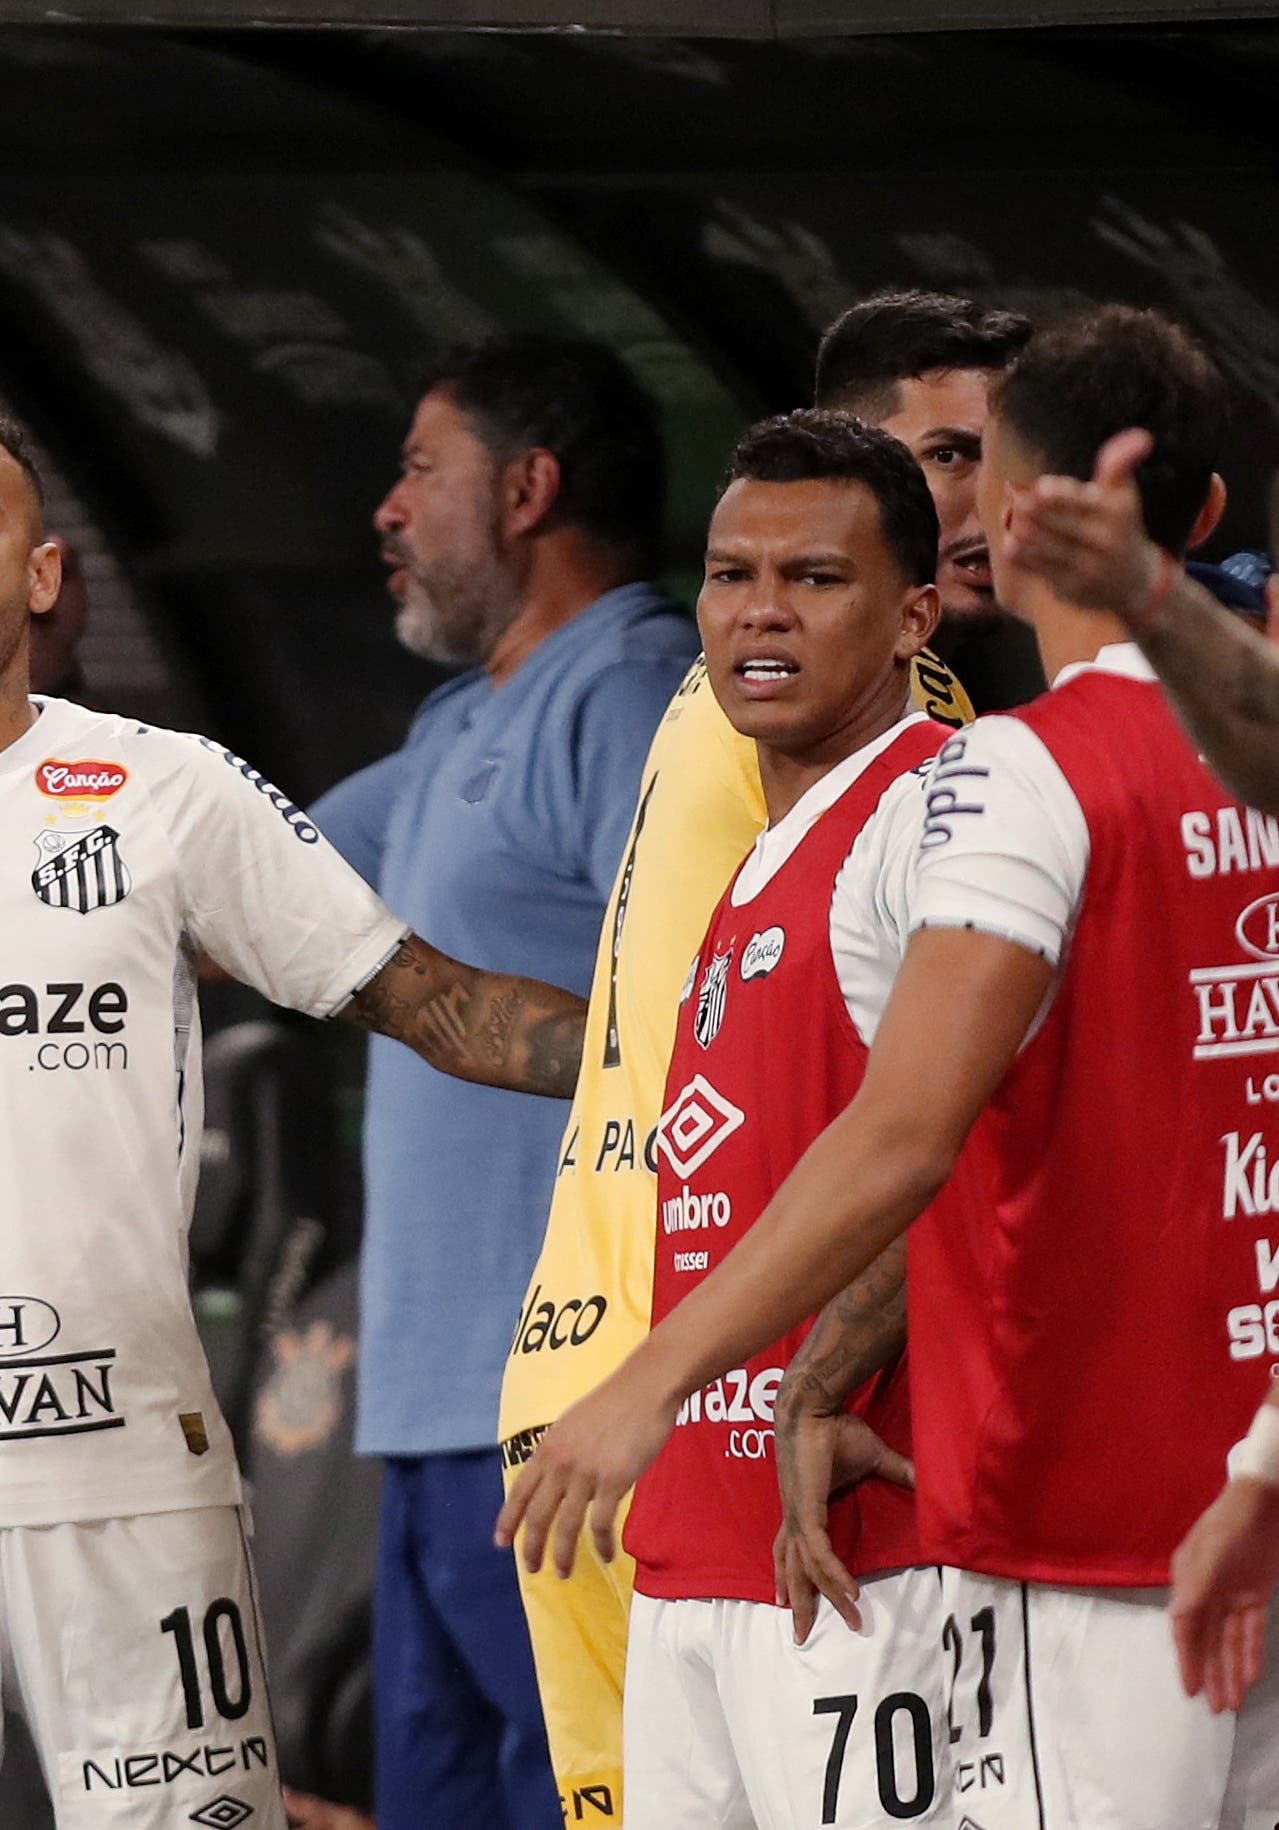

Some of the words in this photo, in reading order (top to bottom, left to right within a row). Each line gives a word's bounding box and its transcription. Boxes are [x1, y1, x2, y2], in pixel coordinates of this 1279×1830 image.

[41, 763, 124, 794] Canção
[28, 1042, 128, 1071] .com
[662, 1184, 732, 1235] umbro
[160, 1596, 251, 1730] 10
[812, 1691, 936, 1825] 70
